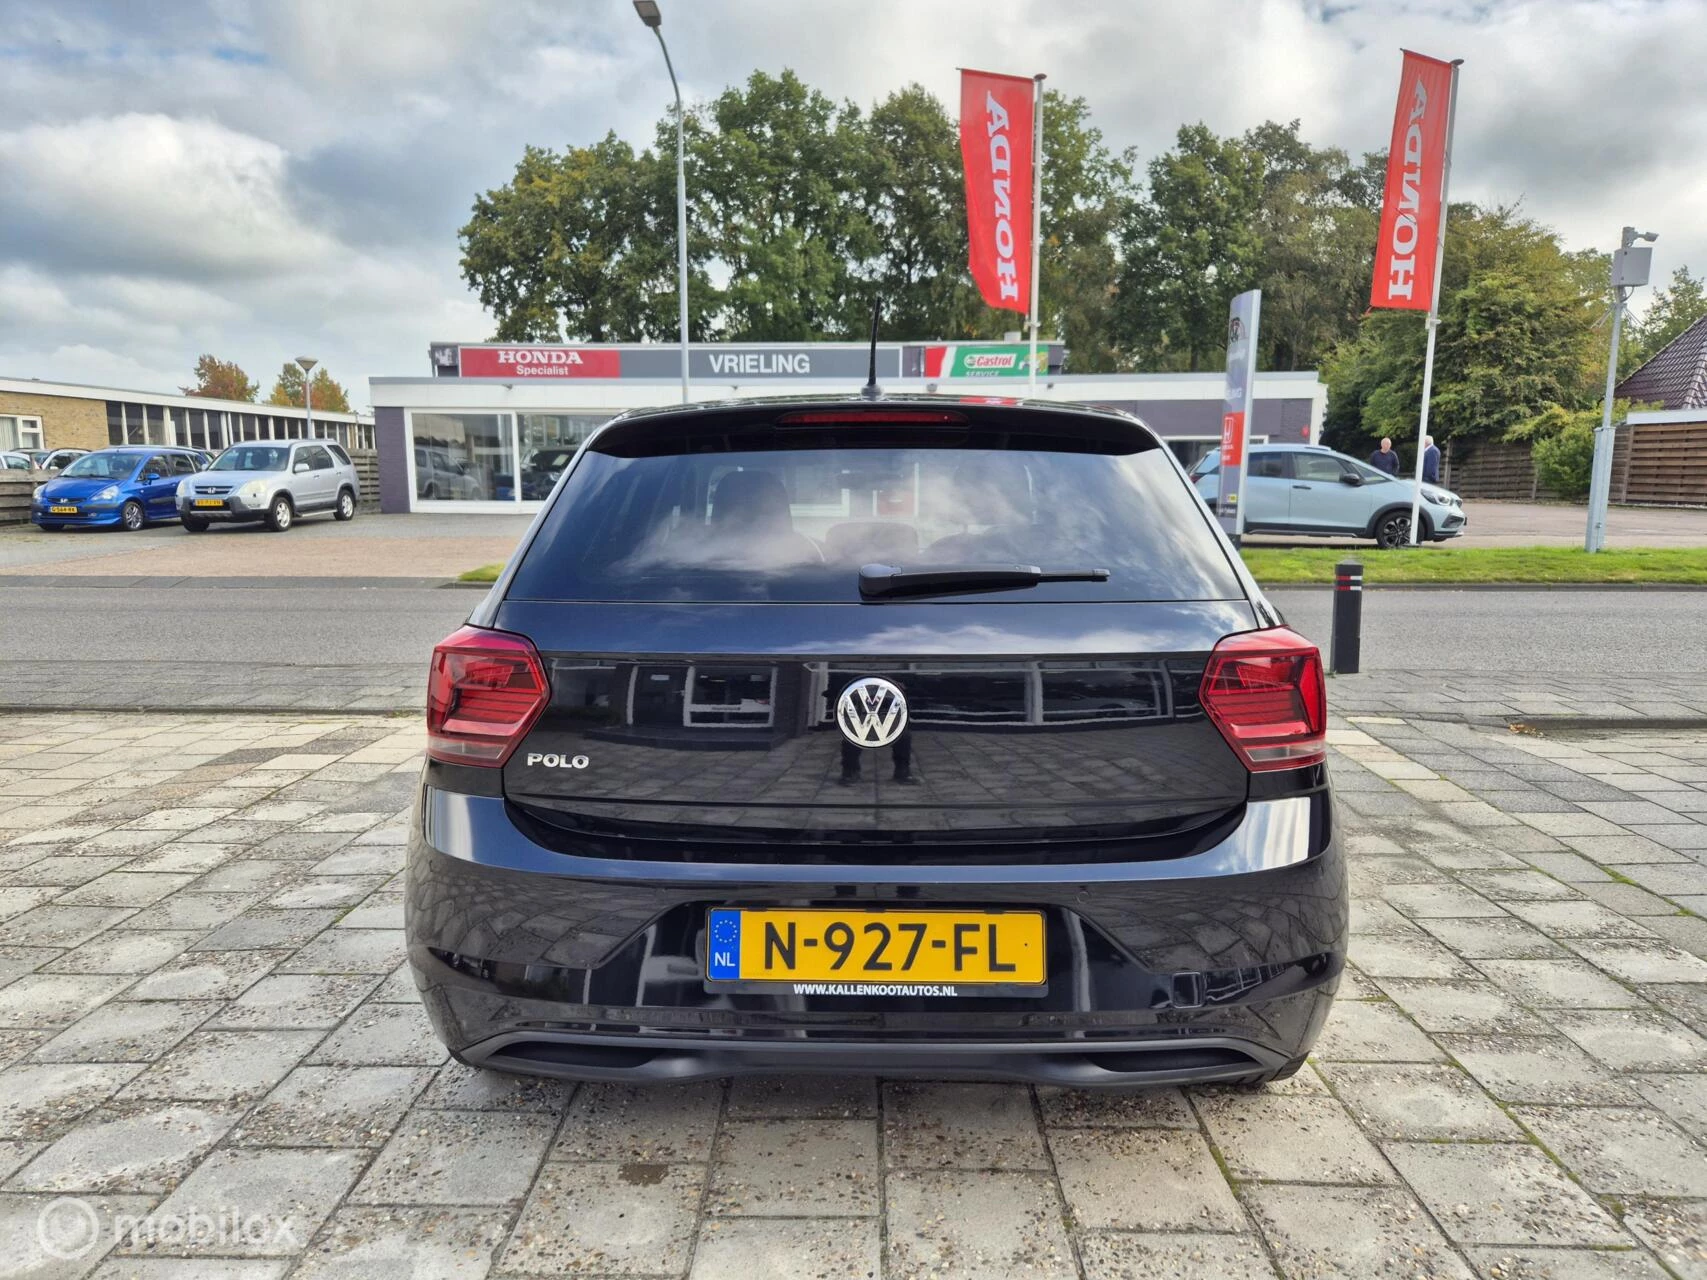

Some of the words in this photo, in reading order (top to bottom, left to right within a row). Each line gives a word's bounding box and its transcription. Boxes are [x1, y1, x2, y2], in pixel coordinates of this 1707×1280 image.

[986, 90, 1019, 302] HONDA
[1388, 79, 1427, 301] HONDA
[497, 350, 584, 365] HONDA
[708, 353, 811, 374] VRIELING
[975, 355, 1014, 366] Castrol
[516, 365, 569, 376] Specialist
[527, 752, 590, 769] POLO
[764, 921, 1016, 972] N-927-FL
[714, 952, 735, 967] NL
[793, 984, 958, 998] WWW.KALLENKOOTAUTOS.NL
